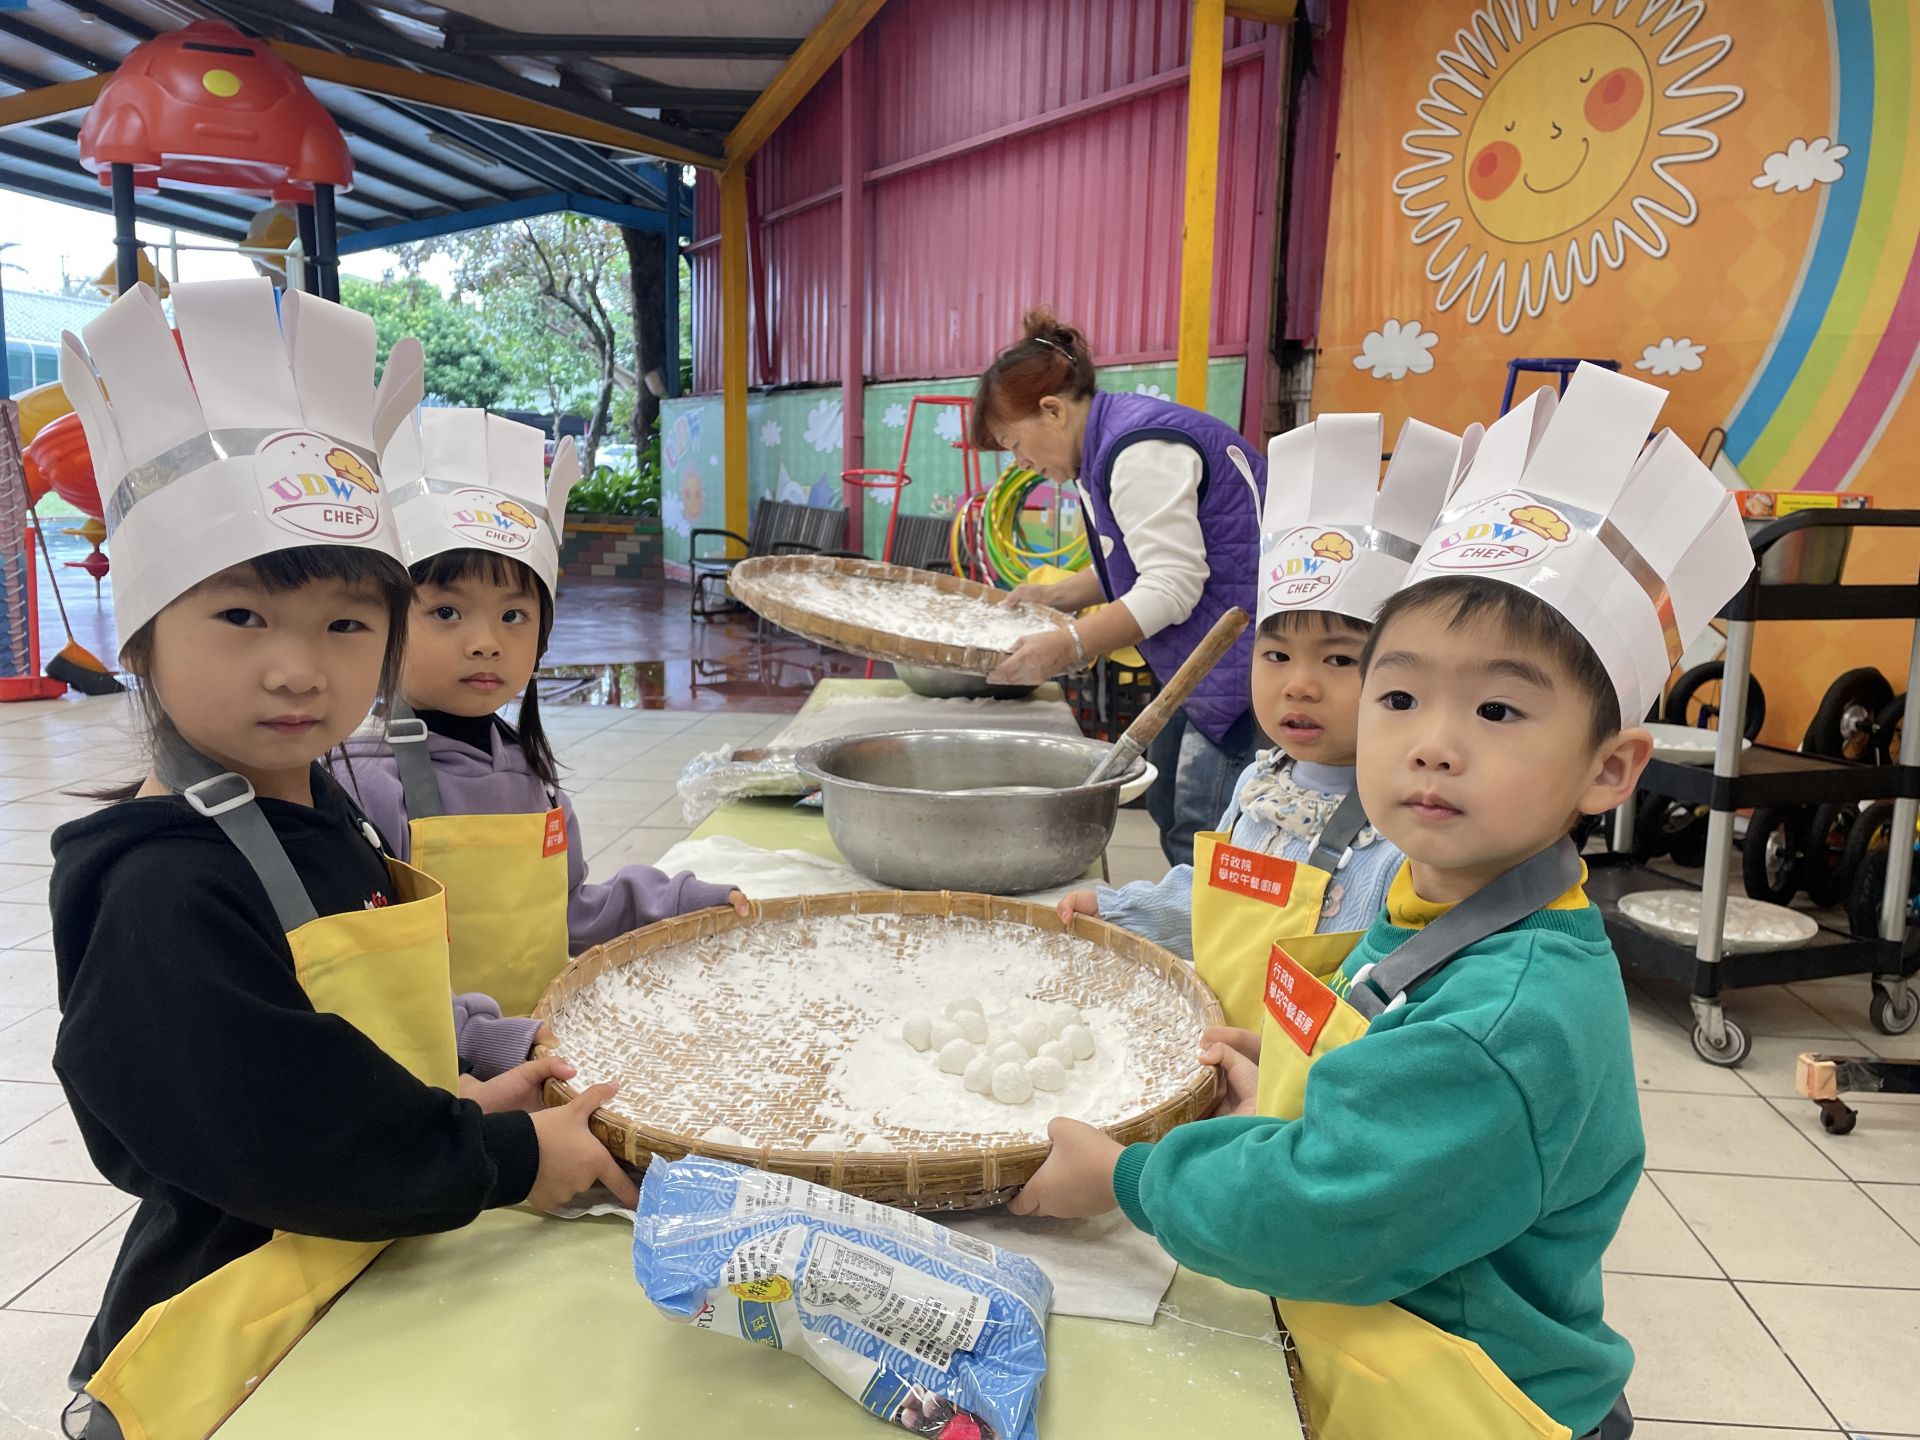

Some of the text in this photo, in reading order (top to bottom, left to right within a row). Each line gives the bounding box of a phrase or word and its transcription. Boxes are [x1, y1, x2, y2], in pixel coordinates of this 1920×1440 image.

[267, 473, 356, 503] UDW
[323, 509, 364, 526] CHEF
[453, 508, 515, 530] UDW
[485, 530, 516, 544] CHEF
[1438, 522, 1527, 550] UDW
[1459, 548, 1510, 560] CHEF
[1270, 556, 1326, 583] UDW
[1286, 582, 1320, 595] CHEF
[1220, 852, 1252, 873] 行政院
[1218, 867, 1282, 896] 學校午餐廚房
[1272, 961, 1296, 995] 行政院
